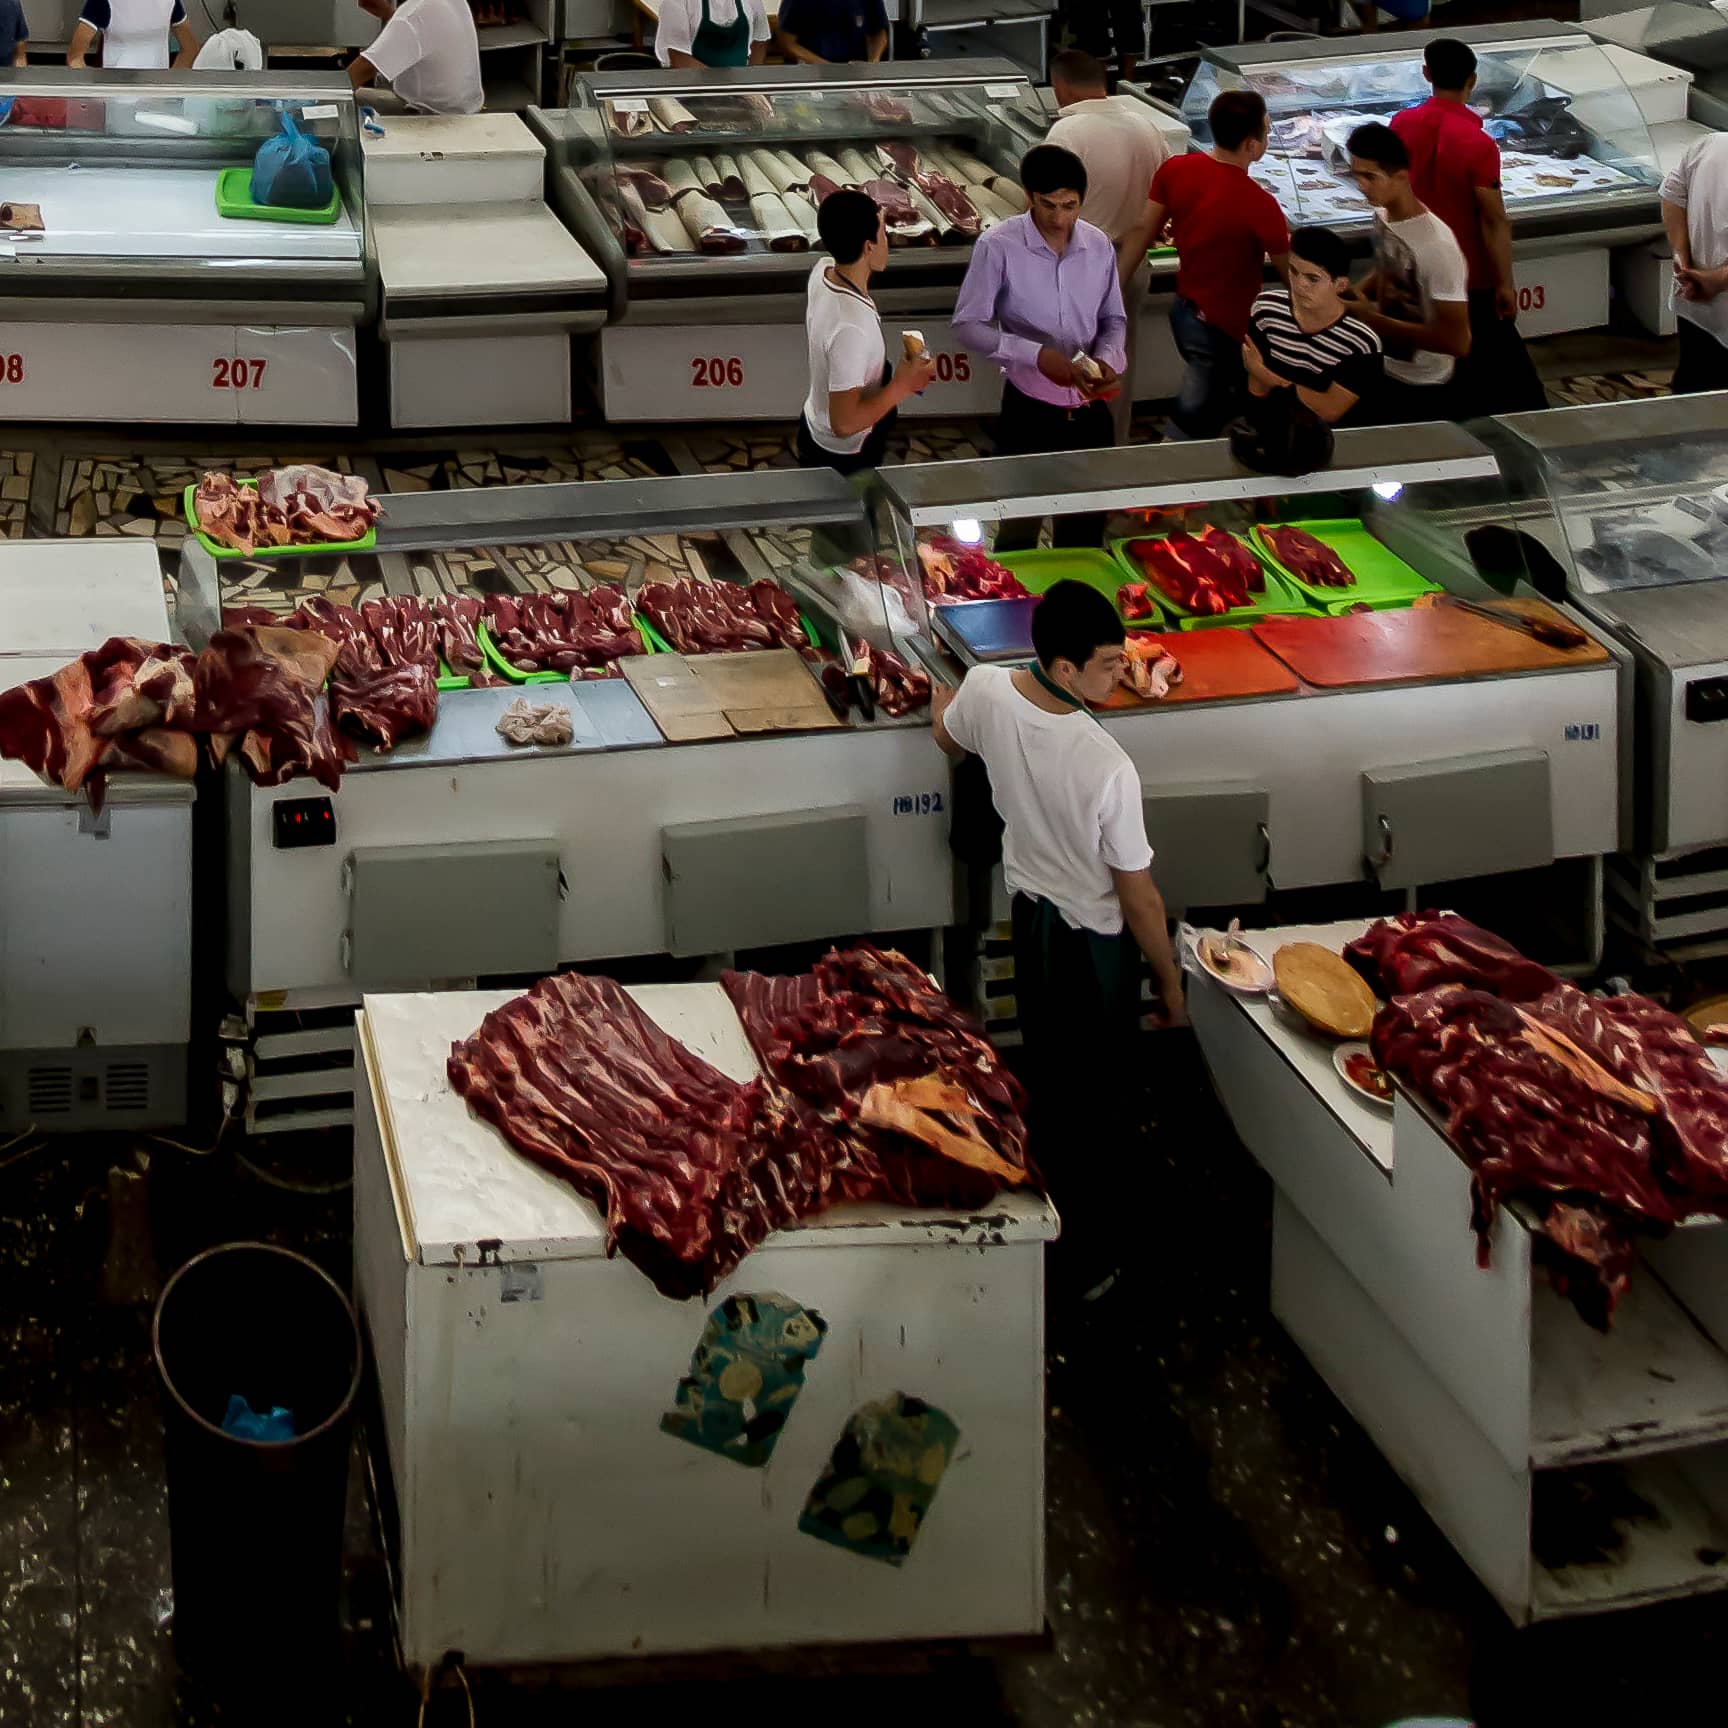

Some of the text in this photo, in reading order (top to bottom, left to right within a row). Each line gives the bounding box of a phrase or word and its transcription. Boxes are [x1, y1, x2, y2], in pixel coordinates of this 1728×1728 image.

[1515, 284, 1545, 311] 03
[212, 358, 267, 389] 207
[691, 357, 744, 387] 206
[930, 352, 971, 383] 05
